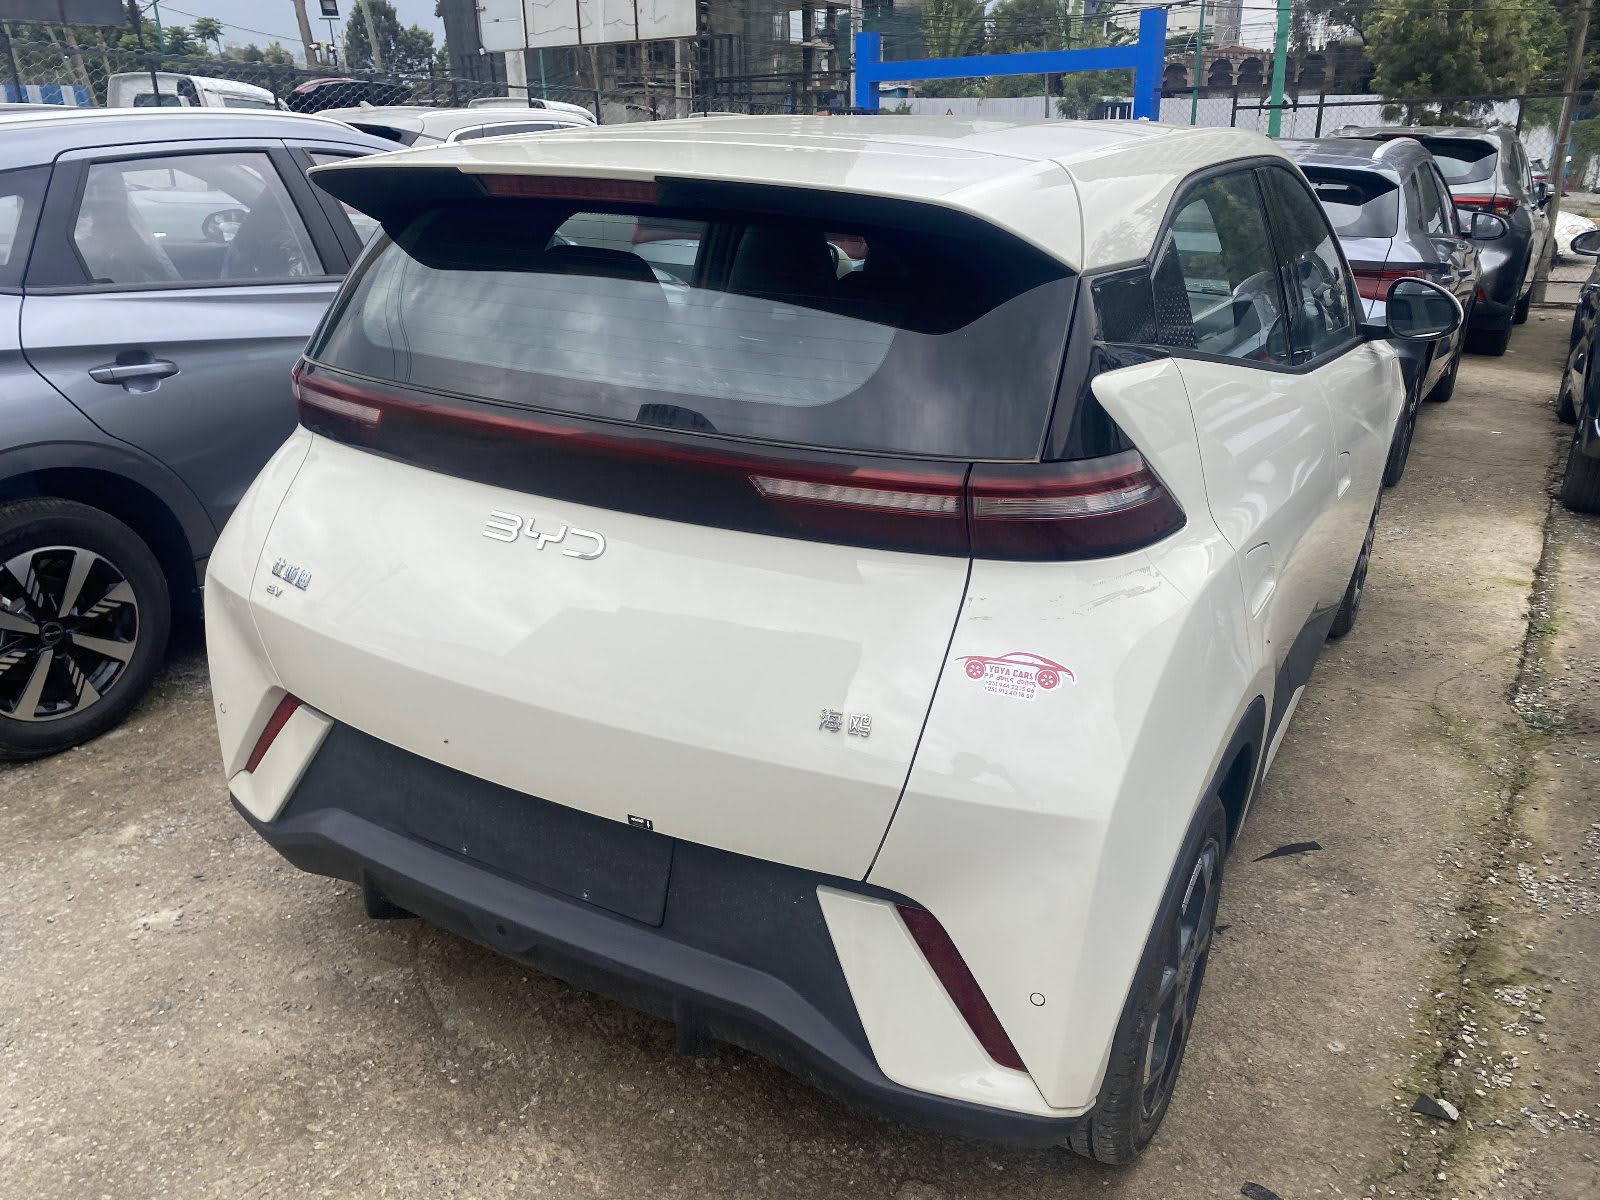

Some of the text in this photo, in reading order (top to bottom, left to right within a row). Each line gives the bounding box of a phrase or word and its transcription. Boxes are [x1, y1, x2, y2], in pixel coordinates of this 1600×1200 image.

[482, 509, 607, 560] BYD
[989, 665, 1034, 680] YOYA CARS
[818, 707, 873, 738] 海鸥
